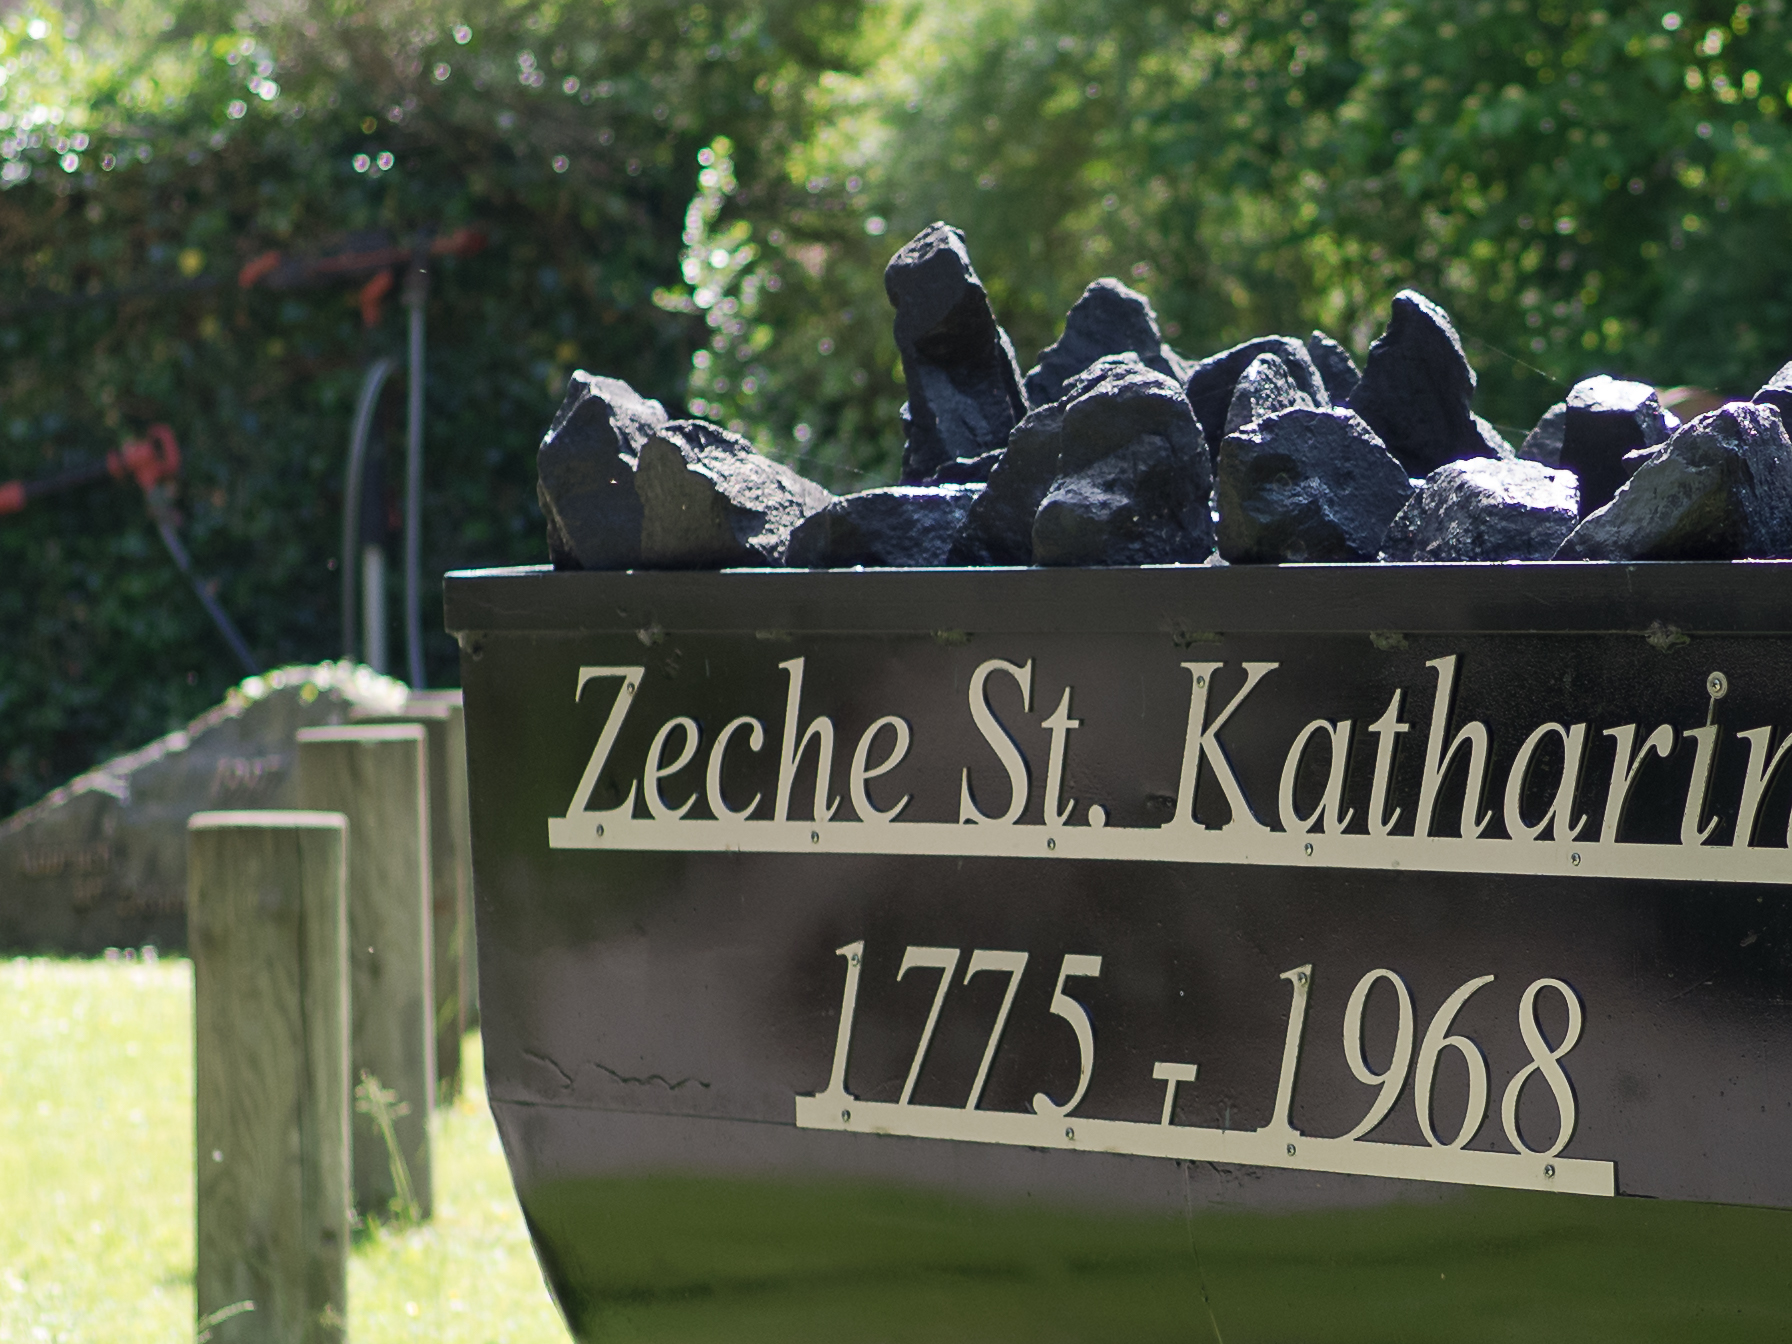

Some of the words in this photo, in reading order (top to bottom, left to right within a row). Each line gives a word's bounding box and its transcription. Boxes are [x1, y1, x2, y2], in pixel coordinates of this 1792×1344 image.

[565, 656, 914, 826] Zeche
[958, 657, 1107, 830] St.
[813, 939, 1103, 1118] 1775
[1255, 963, 1585, 1158] 1968
